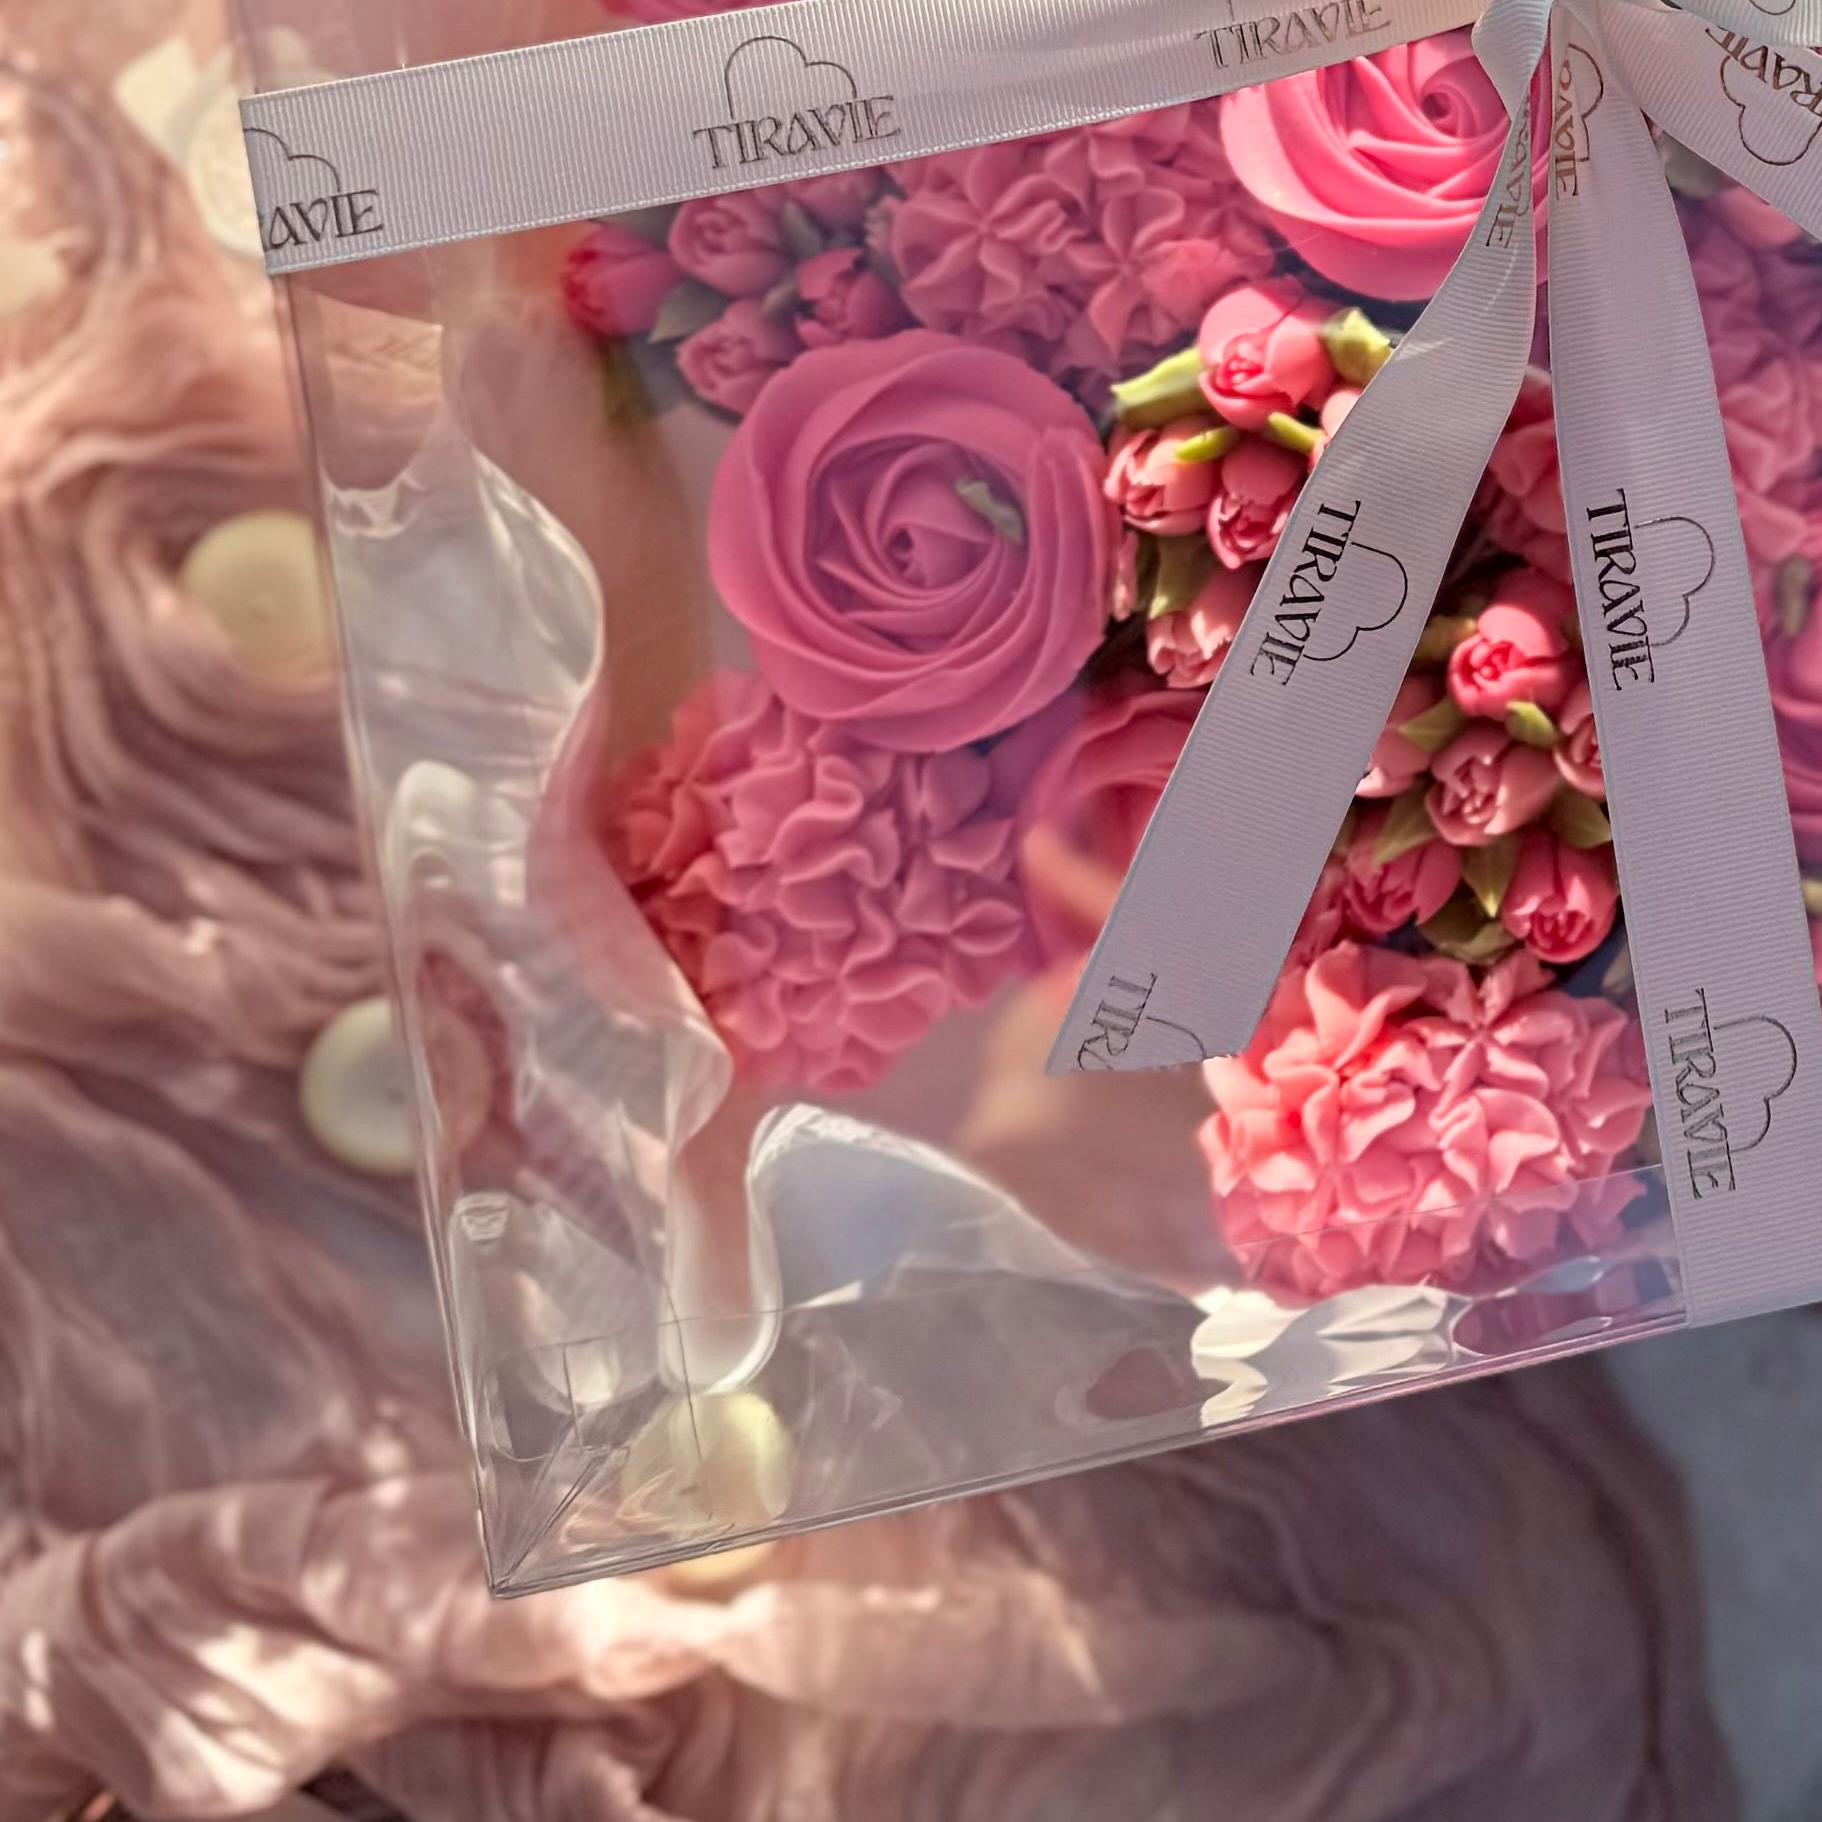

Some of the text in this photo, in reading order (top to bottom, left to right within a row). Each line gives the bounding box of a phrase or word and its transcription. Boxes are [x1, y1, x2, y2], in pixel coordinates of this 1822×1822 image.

[259, 188, 385, 253] AVIE
[693, 94, 899, 170] TIRAVIE
[1249, 499, 1361, 687] TIRAVIE
[1585, 488, 1656, 691] TIRAVIE
[1663, 988, 1736, 1200] TIRAVIE
